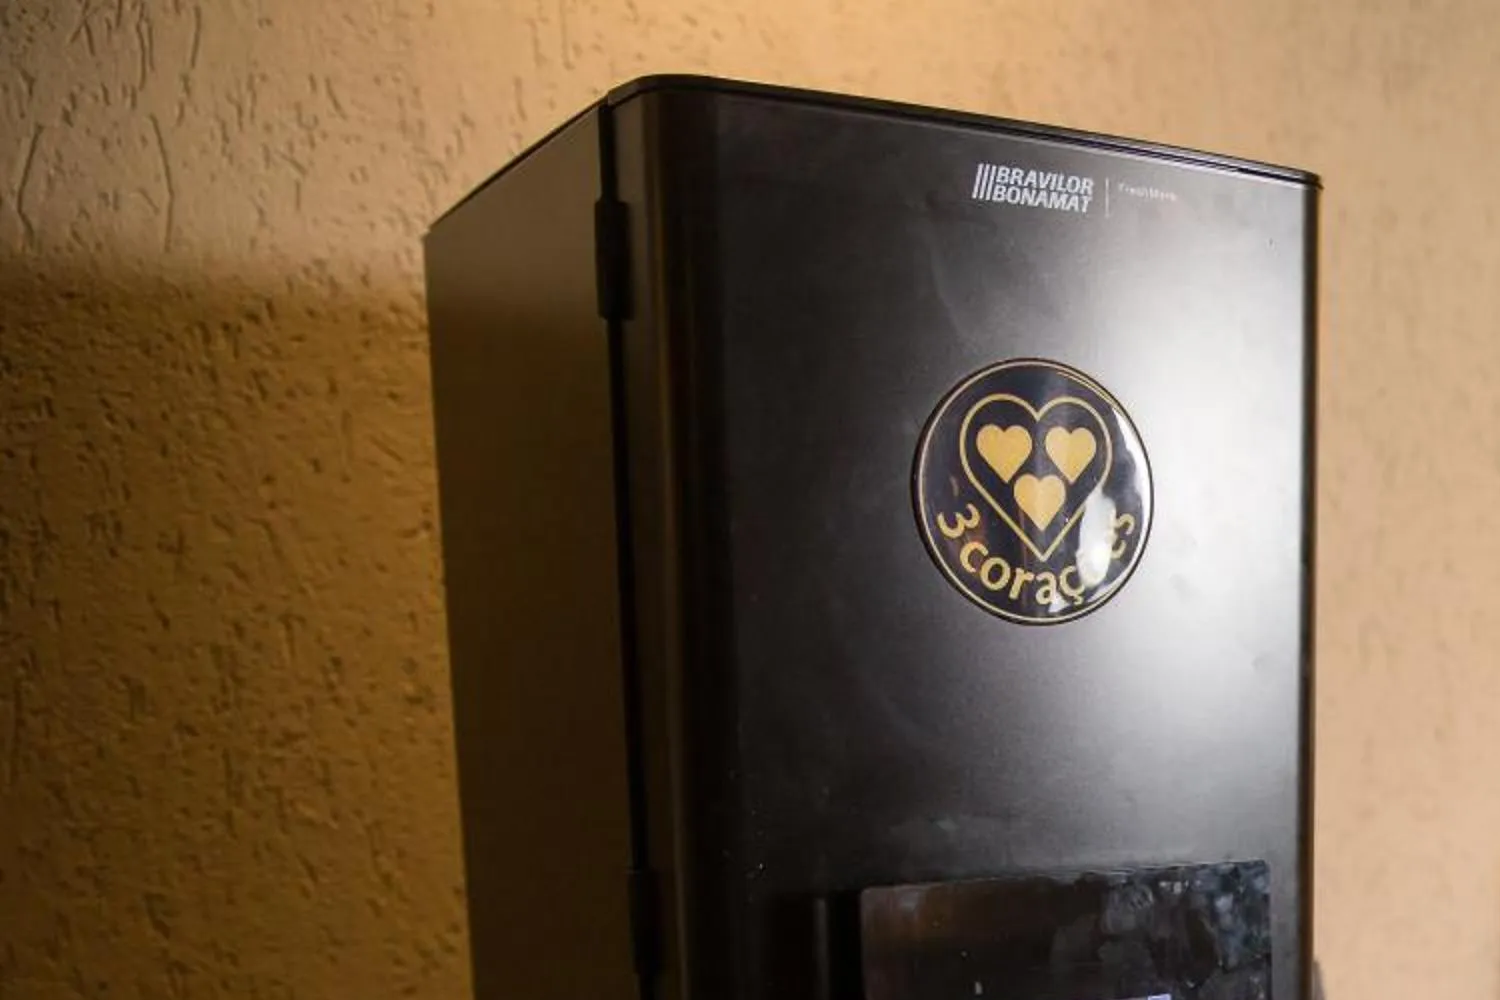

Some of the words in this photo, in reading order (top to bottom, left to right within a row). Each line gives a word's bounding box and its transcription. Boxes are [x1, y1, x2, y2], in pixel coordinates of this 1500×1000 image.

[996, 165, 1094, 195] BRAVILOR
[992, 184, 1093, 213] BONAMAT
[936, 503, 981, 539] 3
